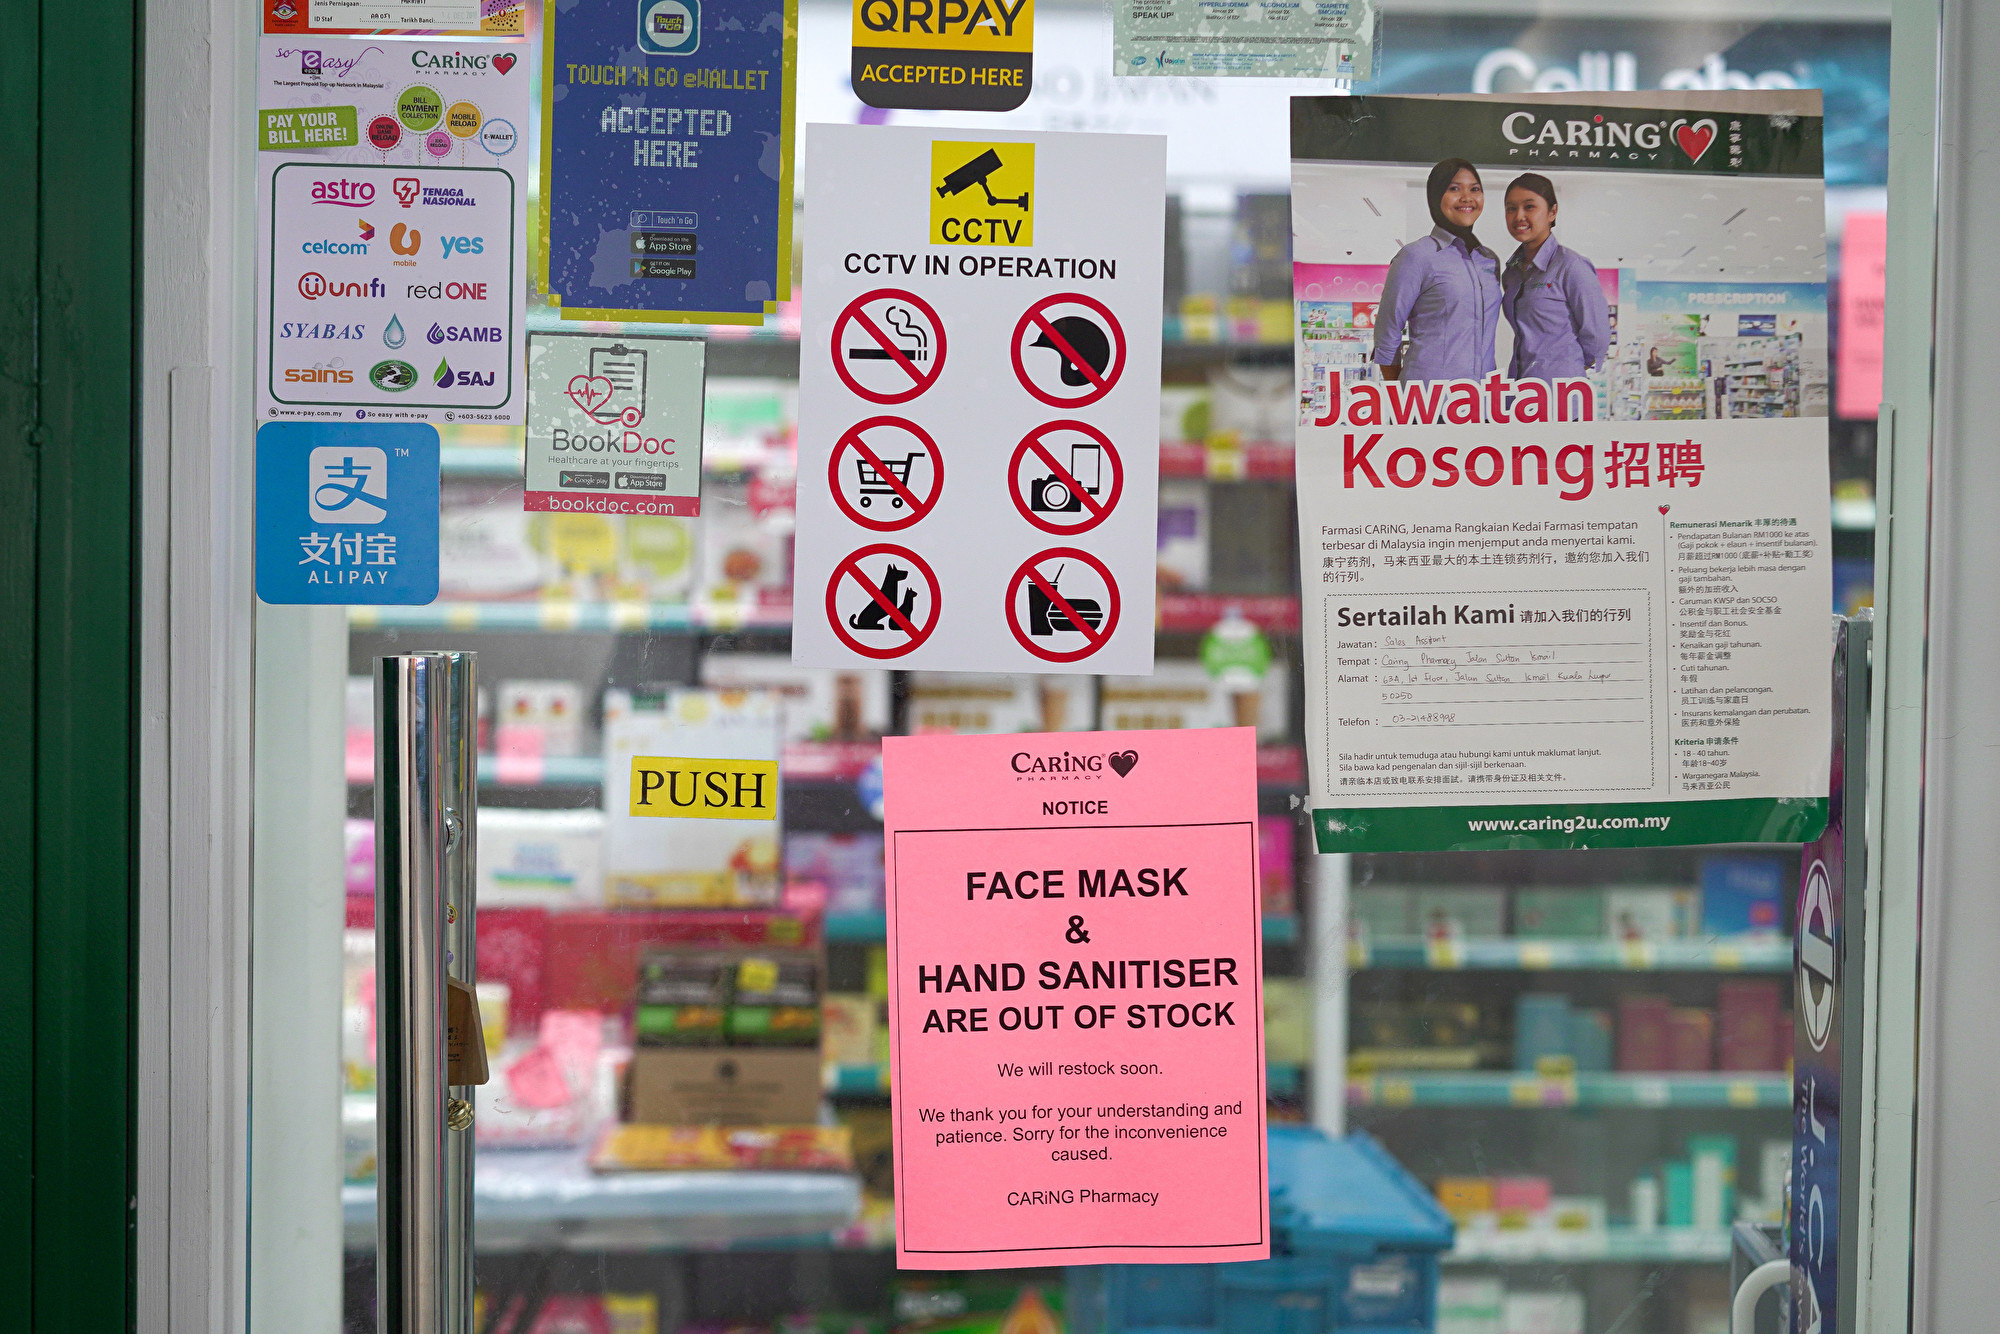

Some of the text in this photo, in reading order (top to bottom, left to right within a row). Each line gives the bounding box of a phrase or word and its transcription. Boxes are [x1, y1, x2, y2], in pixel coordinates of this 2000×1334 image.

[861, 0, 1023, 38] QRPAY
[412, 50, 486, 68] CARiNG
[567, 64, 768, 90] TOUCH 'N GO eWALLET
[861, 64, 1023, 86] ACCEPTED HERE
[412, 97, 428, 105] BILL
[268, 113, 337, 129] PAY YOUR
[602, 106, 731, 136] ACCEPTED
[268, 128, 346, 145] BILL HERE!
[484, 134, 514, 142] E-WALLET
[1502, 112, 1661, 148] CARiNG
[634, 139, 698, 168] HERE
[1510, 149, 1657, 160] PHARMACY
[312, 179, 375, 200] astro
[421, 188, 466, 196] TENAGA
[421, 197, 478, 206] NASIONAL
[942, 218, 1022, 243] CCTV
[302, 239, 369, 254] celcom
[440, 236, 484, 259] yes
[845, 253, 1115, 279] CCTV IN OPERATION
[330, 277, 385, 298] unifi
[1689, 292, 1785, 304] PRESCRIPTION
[280, 323, 365, 339] SYABAS
[446, 326, 502, 342] SAMB
[285, 369, 353, 383] sains
[458, 371, 494, 386] SAJ
[1314, 371, 1593, 426] Jawatan
[553, 428, 675, 456] BookDoc
[548, 456, 597, 466] Healthcare
[612, 459, 632, 468] your
[635, 458, 680, 470] fingertips
[1344, 434, 1593, 501] Kosong
[1604, 440, 1704, 488] 招聘
[550, 496, 674, 514] bookdoc.com
[1322, 521, 1638, 535] Farmasi CARiNG, Jenama Rangkaian Kedai Farmasi tempatan
[1322, 535, 1635, 550] terbesar di Malaysia ingin menjemput anda menyertai kami.
[1677, 533, 1720, 541] Pendapatan
[299, 532, 396, 565] 支付宝
[308, 571, 387, 584] ALIPAY
[1323, 571, 1364, 582] 的行列。
[1337, 603, 1632, 627] Sertailah Kami 请加入我们的行列
[1337, 658, 1369, 667] Tempat
[1338, 718, 1370, 726] Telefon
[1011, 752, 1102, 772] CARiNG
[1354, 753, 1373, 761] hadir
[1399, 752, 1439, 760] temuduga
[1459, 751, 1491, 759] hubungi
[1578, 749, 1601, 757] lanjut.
[637, 770, 766, 808] PUSH
[1043, 801, 1108, 815] NOTICE
[1468, 816, 1670, 833] www.caring2u.com.my
[968, 868, 1188, 900] FACE MASK
[1066, 915, 1090, 944] &
[919, 958, 1238, 993] HAND SANITISER
[923, 1002, 1235, 1033] ARE OUT OF STOCK
[998, 1061, 1162, 1077] We will restock soon.
[919, 1101, 1241, 1123] We thank you for your understanding and
[936, 1125, 1227, 1147] patience. Sorry for the inconvenience
[1052, 1147, 1112, 1161] caused.
[1008, 1190, 1158, 1206] CARiNG Pharmacy
